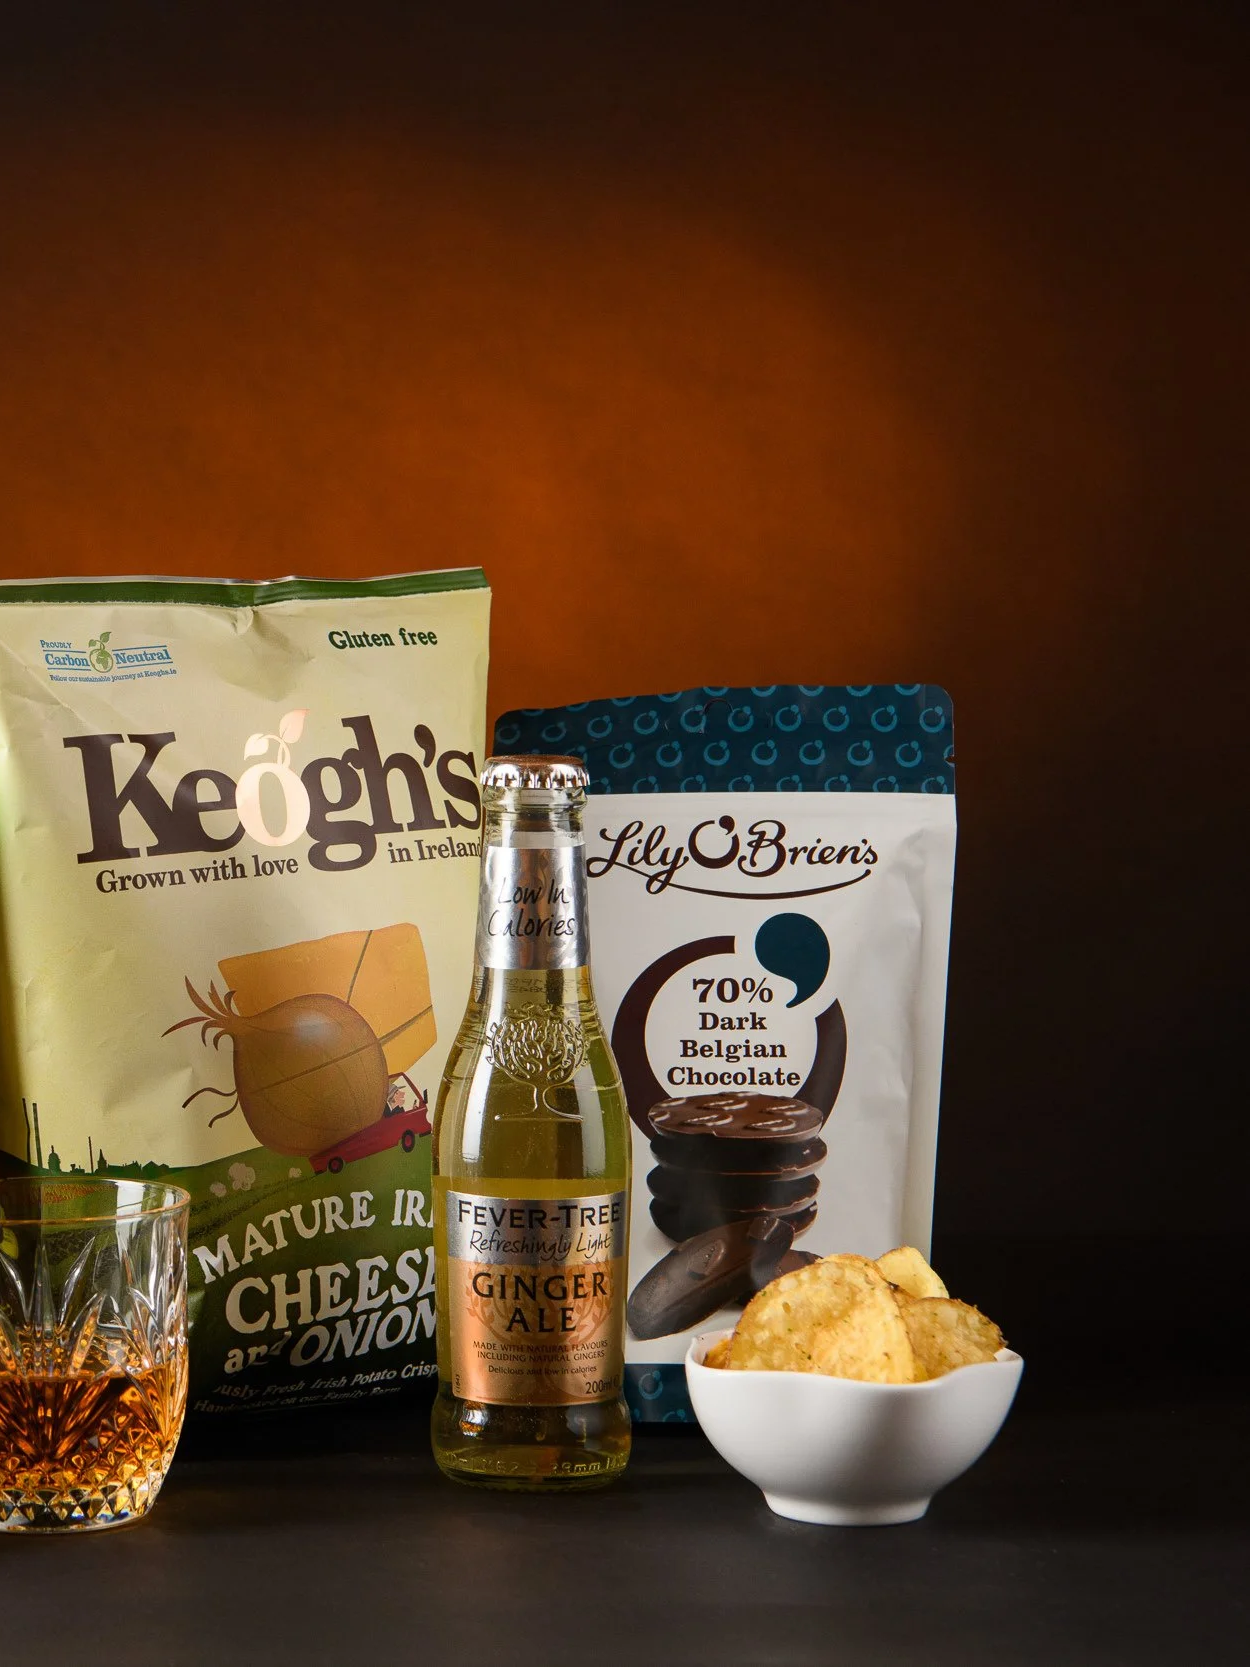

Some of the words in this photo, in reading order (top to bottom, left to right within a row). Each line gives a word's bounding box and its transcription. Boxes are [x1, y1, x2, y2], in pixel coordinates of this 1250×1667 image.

[328, 630, 394, 650] Gluten
[399, 627, 438, 648] free
[45, 653, 91, 667] Carbon
[113, 649, 172, 664] Neutral
[111, 674, 136, 682] journey
[63, 714, 483, 872] Keogh's
[388, 842, 412, 863] in
[586, 820, 689, 894] Lily
[95, 868, 186, 894] Grown
[190, 857, 247, 884] with
[252, 854, 299, 877] love
[497, 877, 544, 906] Low
[548, 878, 570, 905] In
[487, 908, 576, 938] Calories
[692, 977, 774, 1004] 70%
[698, 1011, 768, 1031] Dark
[679, 1039, 788, 1063] Belgian
[667, 1065, 801, 1087] Chocolate
[458, 1199, 620, 1229] FEVER-TREE
[193, 1190, 377, 1284] MATURE
[469, 1230, 572, 1262] Refreshingly
[576, 1233, 611, 1256] Light
[472, 1271, 607, 1301] GINGER
[506, 1307, 577, 1333] ALE
[473, 1341, 497, 1350] MADE
[500, 1344, 525, 1352] WITH
[526, 1344, 570, 1352] NATURAL
[572, 1340, 608, 1351] FLAVOURS
[477, 1351, 526, 1362] INCLUDING
[529, 1354, 570, 1362] NATURAL
[573, 1350, 605, 1361] GINGERS
[310, 1376, 346, 1389] Irish
[352, 1369, 397, 1386] Potato
[488, 1365, 523, 1375] Delicious
[527, 1367, 542, 1375] and
[544, 1367, 559, 1375] low
[571, 1365, 597, 1374] calories
